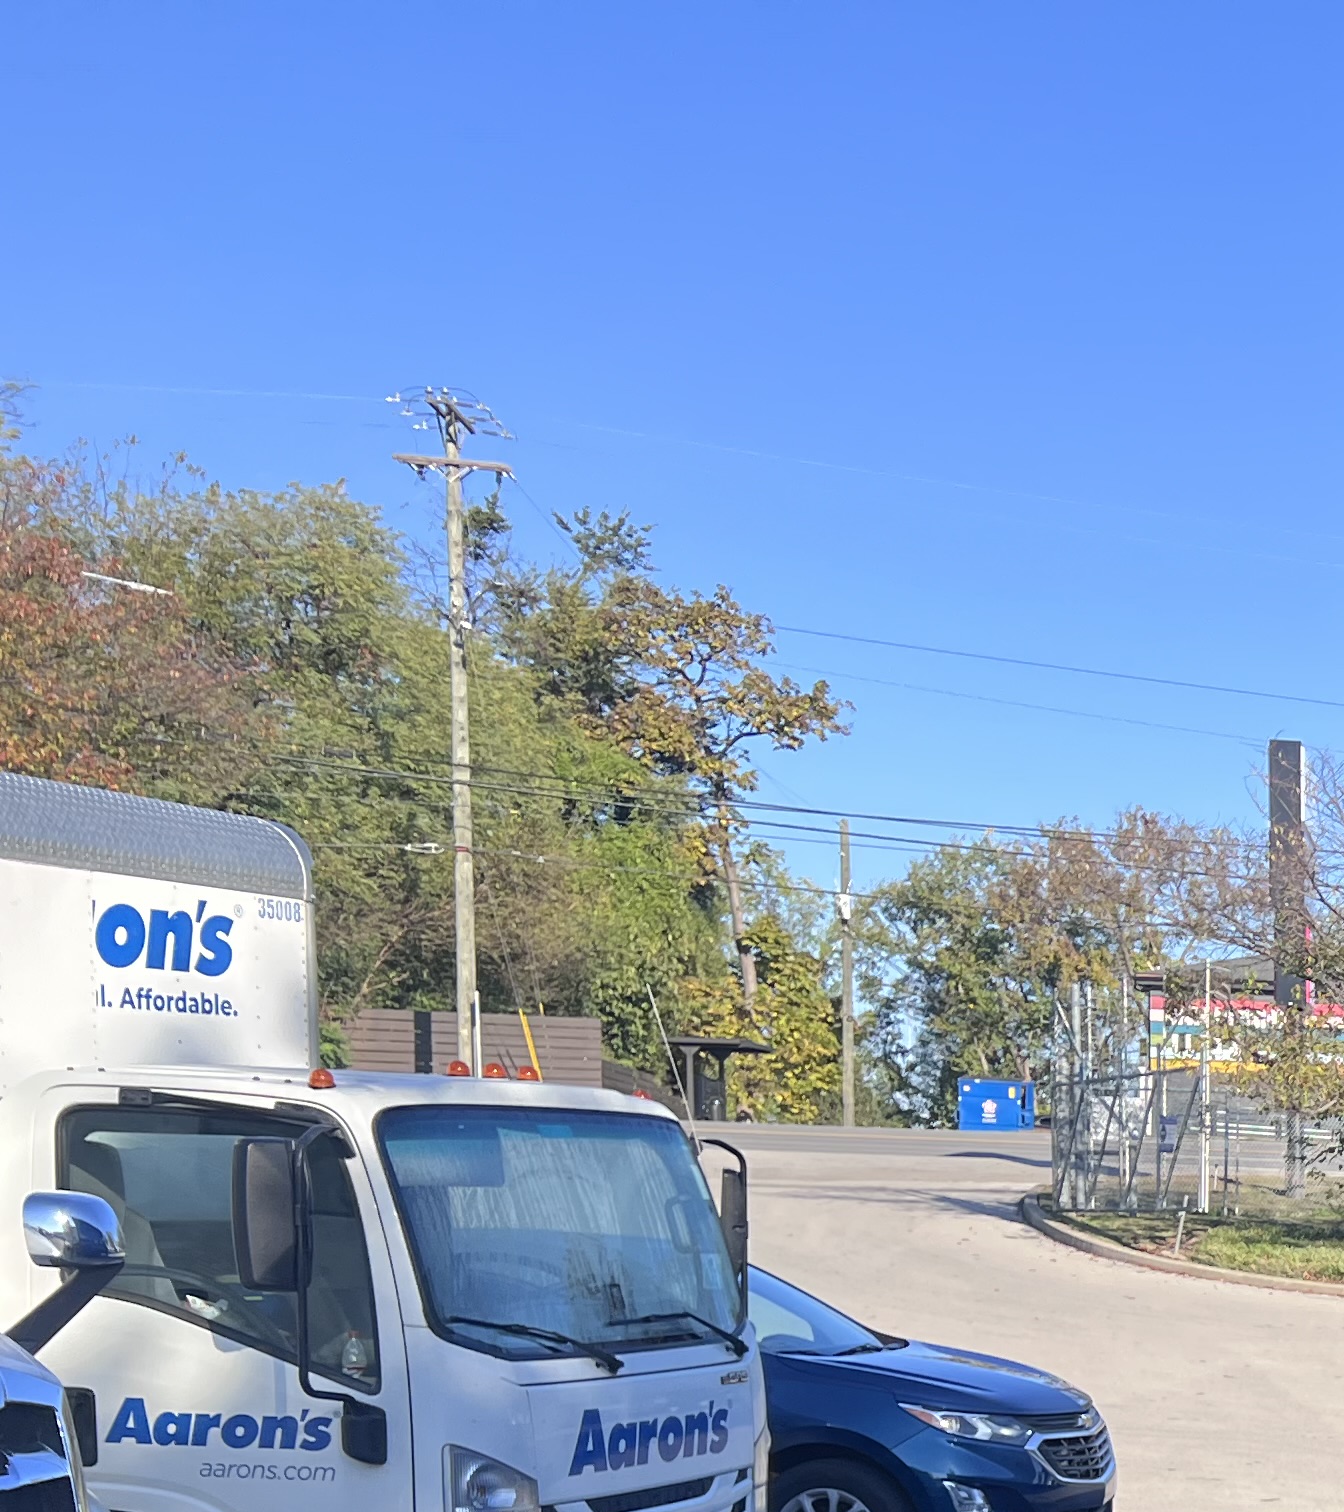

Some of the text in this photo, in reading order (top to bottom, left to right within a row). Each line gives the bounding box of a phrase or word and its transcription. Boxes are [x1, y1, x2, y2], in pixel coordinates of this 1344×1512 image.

[257, 897, 302, 923] 35008
[92, 900, 234, 977] on's
[119, 986, 239, 1017] Affordable.
[105, 1397, 333, 1451] Aaron's
[568, 1400, 729, 1477] Aaron's
[199, 1461, 336, 1482] aarons.com
